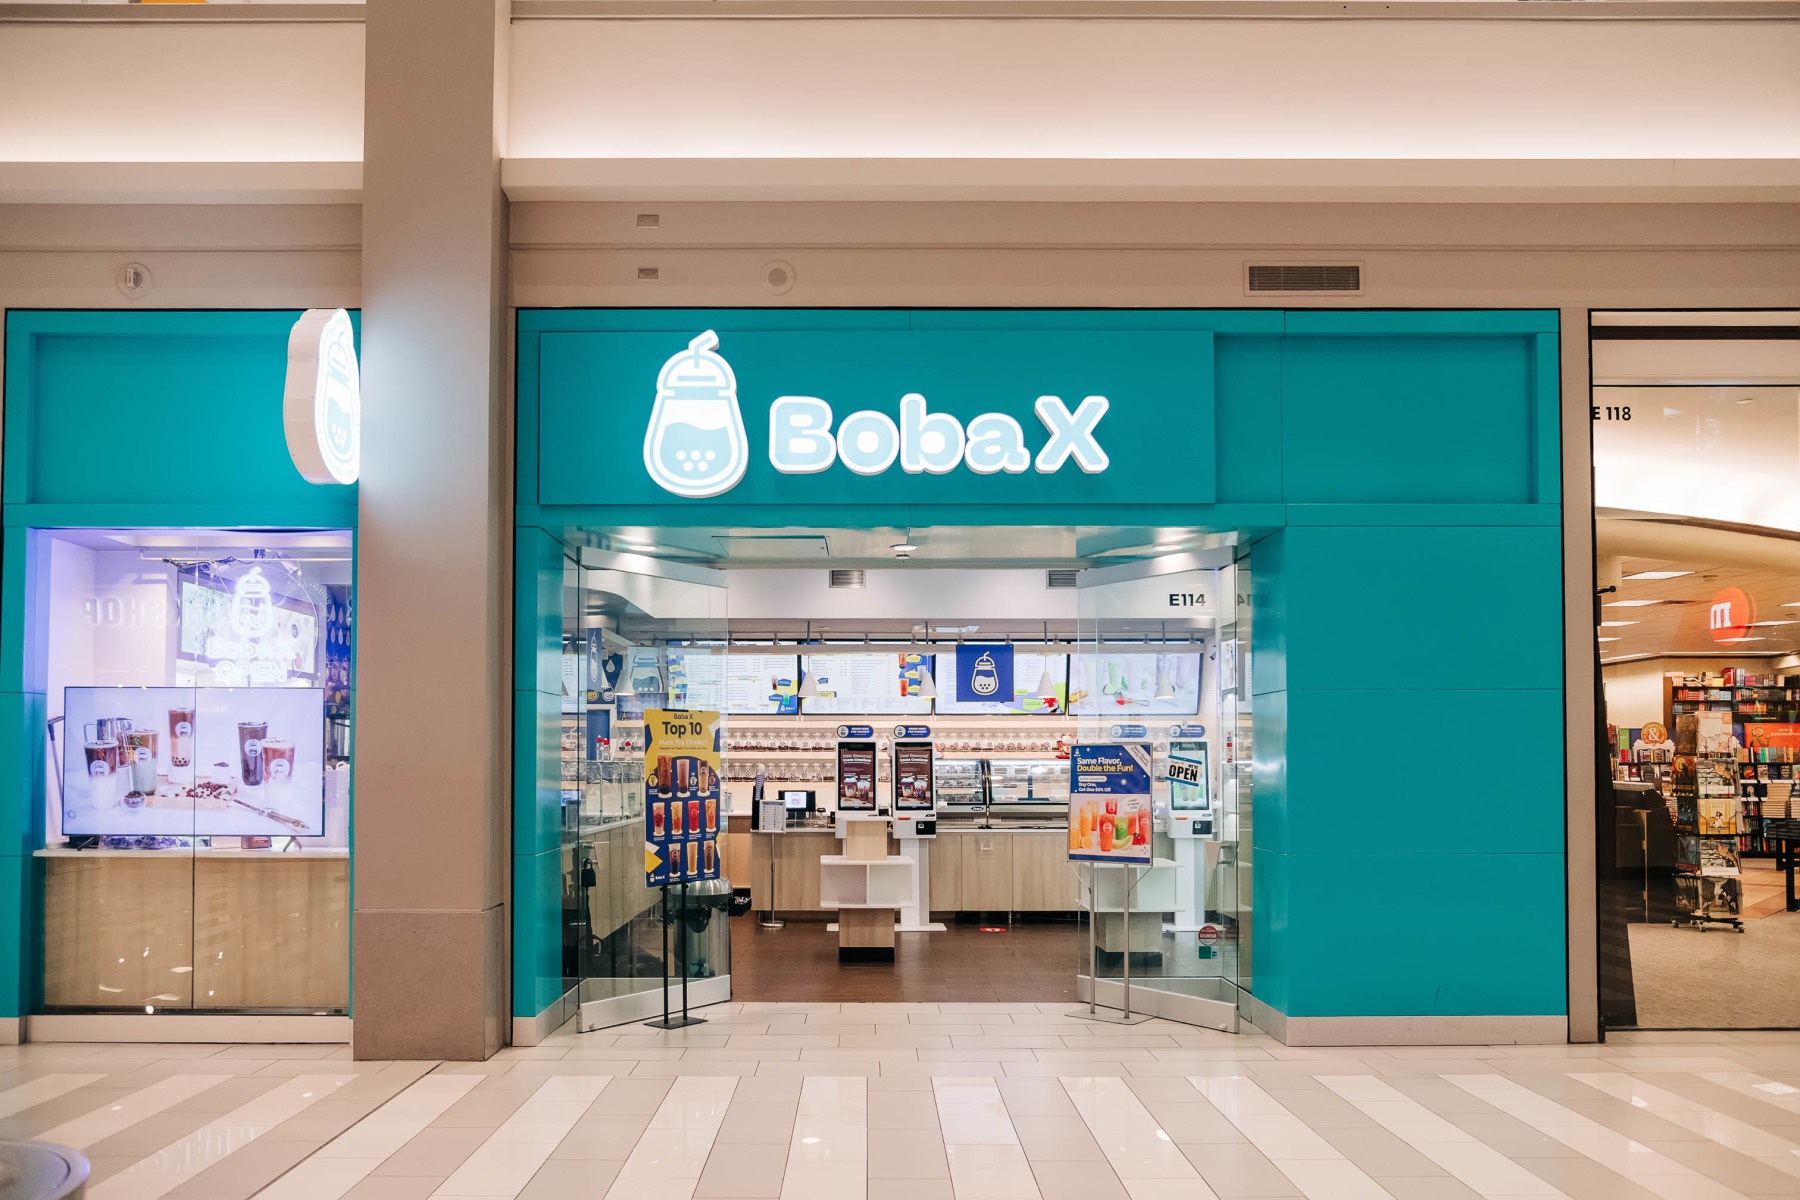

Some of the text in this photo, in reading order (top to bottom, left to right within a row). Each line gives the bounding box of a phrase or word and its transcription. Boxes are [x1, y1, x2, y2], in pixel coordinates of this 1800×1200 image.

[1592, 406, 1632, 421] E 118
[769, 393, 1110, 475] Boba X
[1169, 593, 1206, 607] E114
[206, 637, 297, 660] Boba X
[215, 661, 288, 683] OPEN
[662, 721, 703, 739] Top 10
[1076, 757, 1122, 765] Same Flavor,
[1076, 764, 1134, 772] Double the Fun!
[1168, 764, 1198, 782] OPEN
